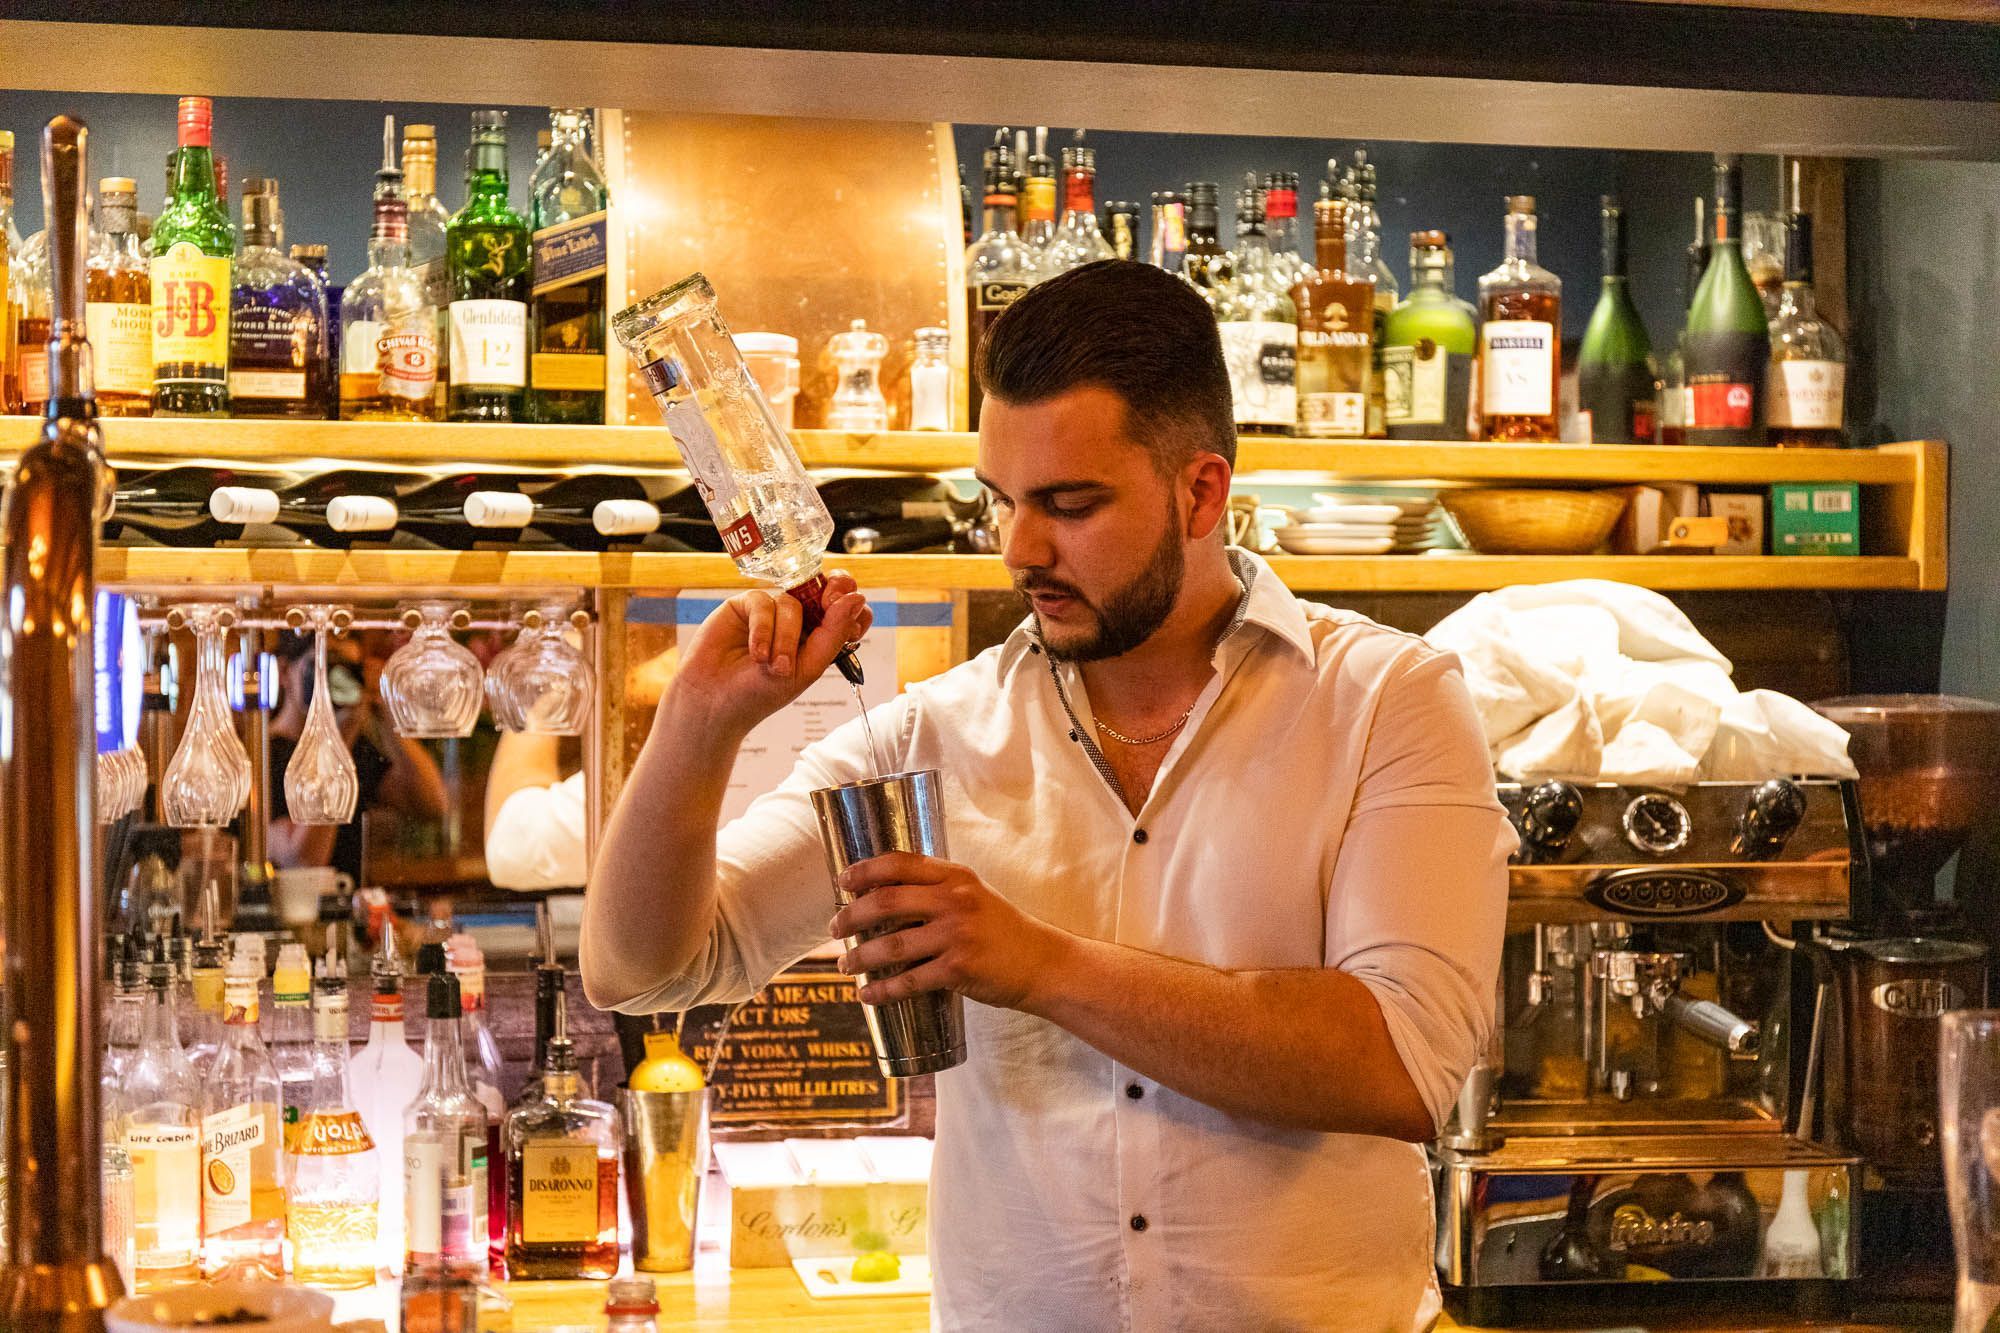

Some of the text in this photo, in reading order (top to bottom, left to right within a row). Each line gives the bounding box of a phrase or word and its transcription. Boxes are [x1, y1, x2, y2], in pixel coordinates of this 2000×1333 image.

[482, 337, 511, 367] 12
[774, 986, 858, 1003] MEASUR
[773, 1007, 811, 1025] 1985
[694, 1042, 872, 1060] RUM VODKA WHISKY
[774, 1080, 879, 1097] MILLILITRES
[215, 1124, 259, 1156] BRIZARD
[529, 1178, 593, 1193] DISARONNO
[740, 1210, 848, 1240] Gordon's
